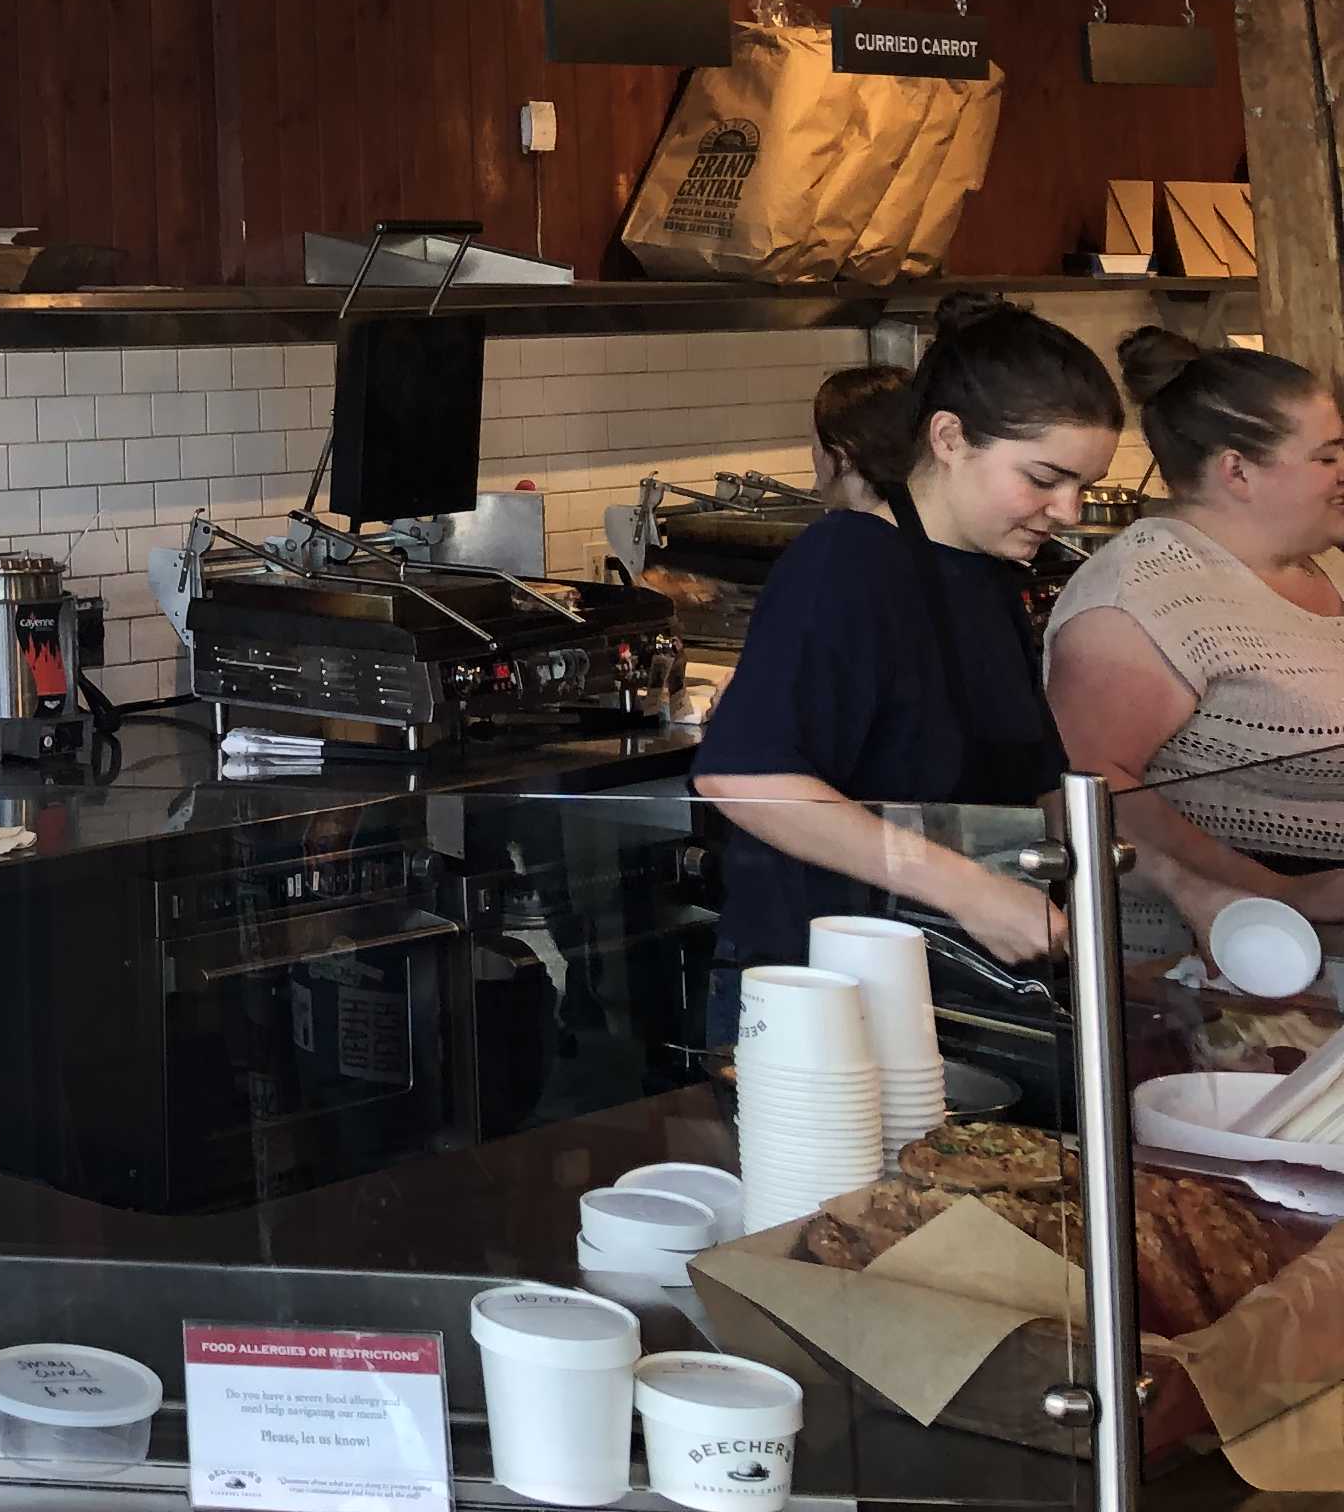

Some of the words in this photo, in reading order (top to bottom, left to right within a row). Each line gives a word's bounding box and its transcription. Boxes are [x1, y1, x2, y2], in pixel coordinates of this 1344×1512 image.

[855, 32, 918, 54] CURRIED
[921, 38, 979, 58] CARROT
[687, 154, 756, 178] GRAND
[676, 179, 744, 200] CENTRAL
[19, 616, 55, 630] cayenne
[201, 1342, 235, 1353] FOOD
[238, 1343, 306, 1357] ALLERGIES
[312, 1347, 326, 1357] OR
[329, 1347, 420, 1362] RESTRICTIONS
[225, 1388, 240, 1400] Do
[241, 1391, 261, 1403] you
[262, 1390, 284, 1401] have
[294, 1394, 323, 1403] severe
[325, 1393, 346, 1404] food
[349, 1395, 380, 1407] allergy
[240, 1404, 262, 1414] need
[264, 1404, 285, 1417] help
[287, 1407, 336, 1420] navigating
[337, 1410, 355, 1419] our
[260, 1429, 299, 1446] Please,
[301, 1431, 316, 1444] let
[318, 1435, 332, 1446] us
